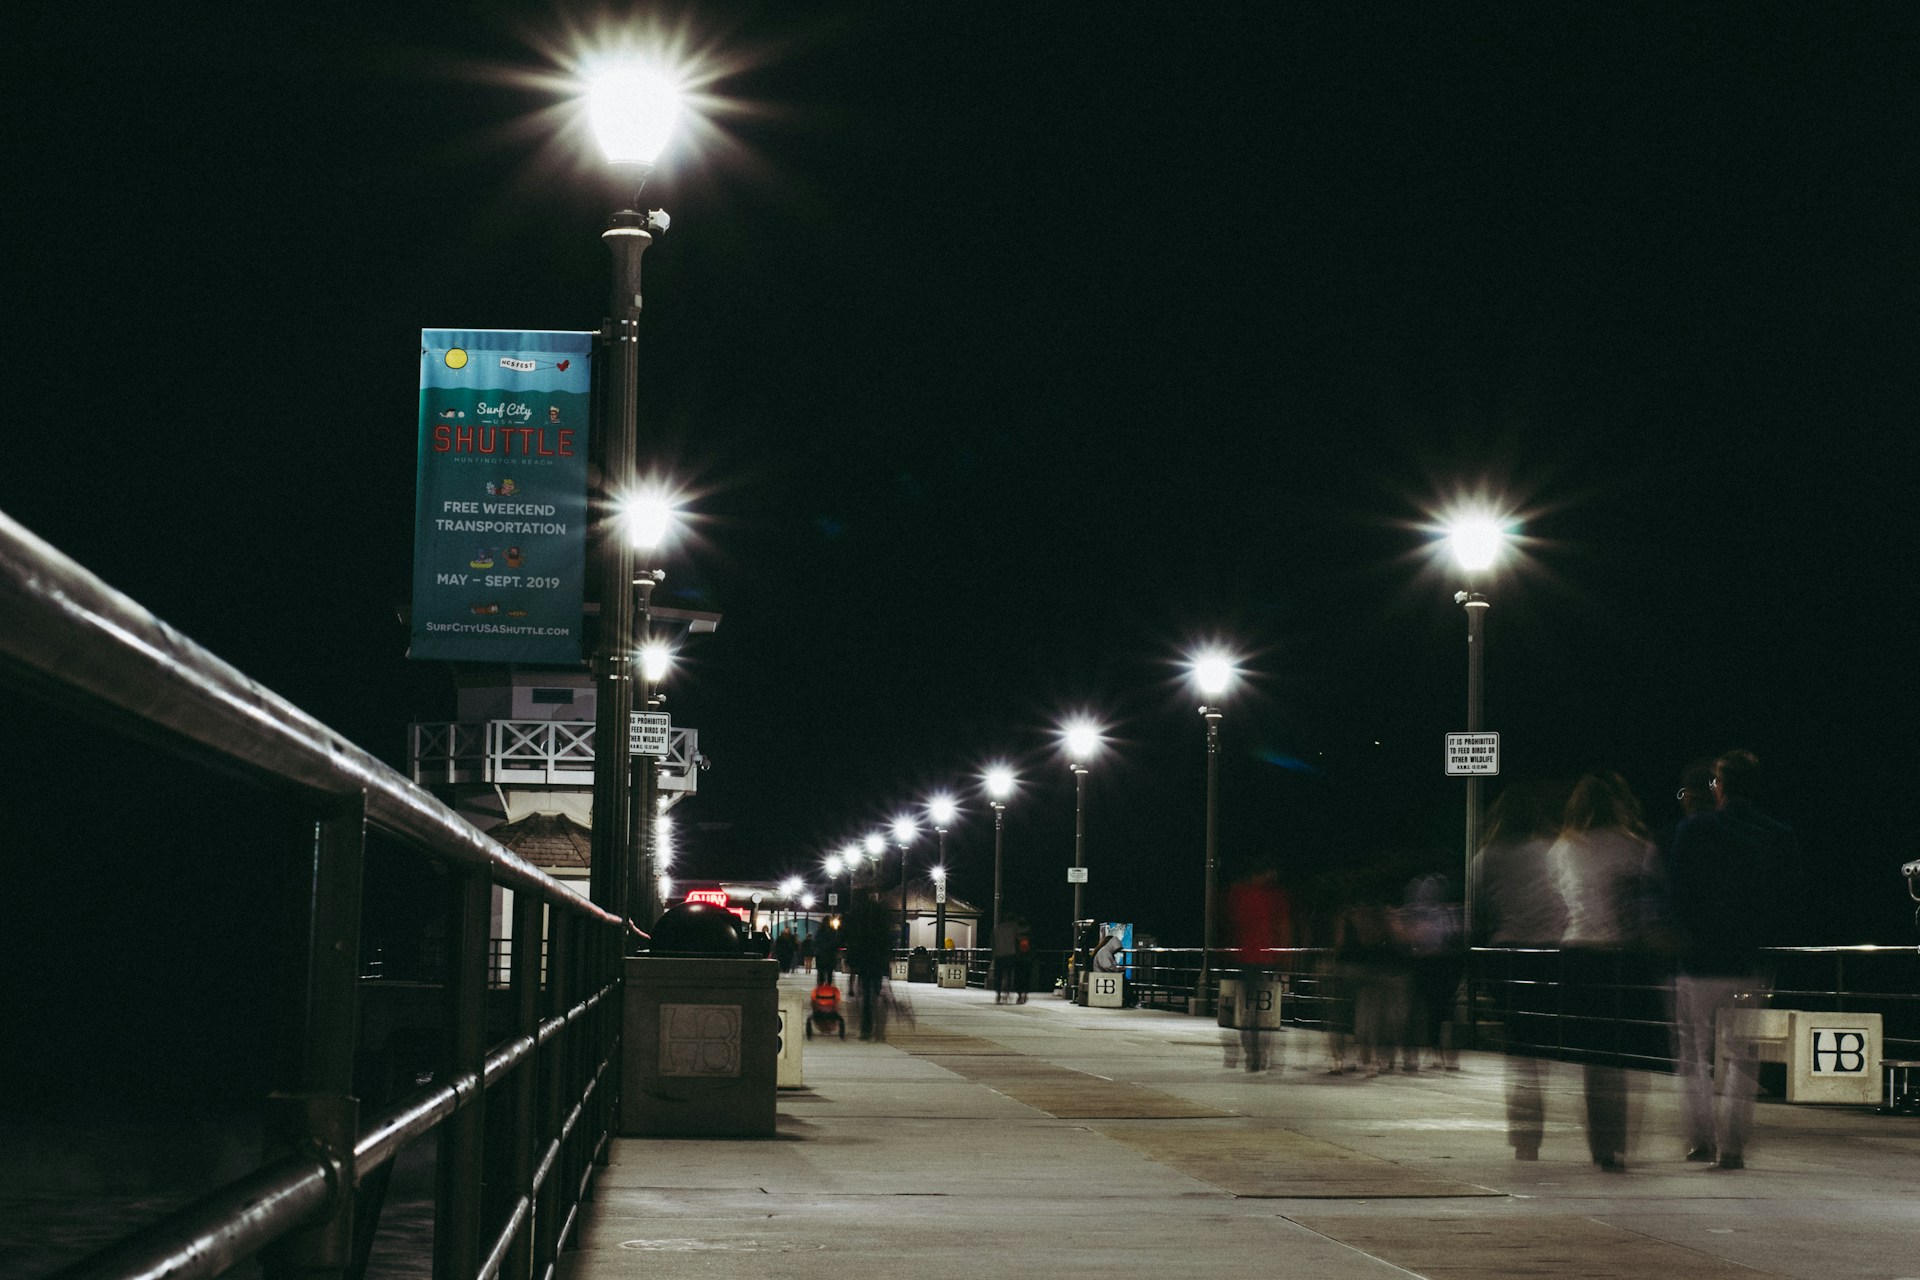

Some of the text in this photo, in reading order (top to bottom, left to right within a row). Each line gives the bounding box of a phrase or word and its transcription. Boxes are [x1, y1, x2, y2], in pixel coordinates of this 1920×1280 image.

[476, 402, 532, 420] Surf City
[433, 425, 575, 456] SHUTTLE
[443, 501, 556, 516] FREE WEEKEND
[436, 519, 566, 535] TRANSPORTATION
[437, 573, 468, 585] MAY
[485, 575, 522, 588] SEPT.
[526, 577, 560, 589] 2019
[638, 717, 667, 725] PROHIBITED
[1096, 979, 1115, 994] HB
[1813, 1032, 1864, 1072] HB
